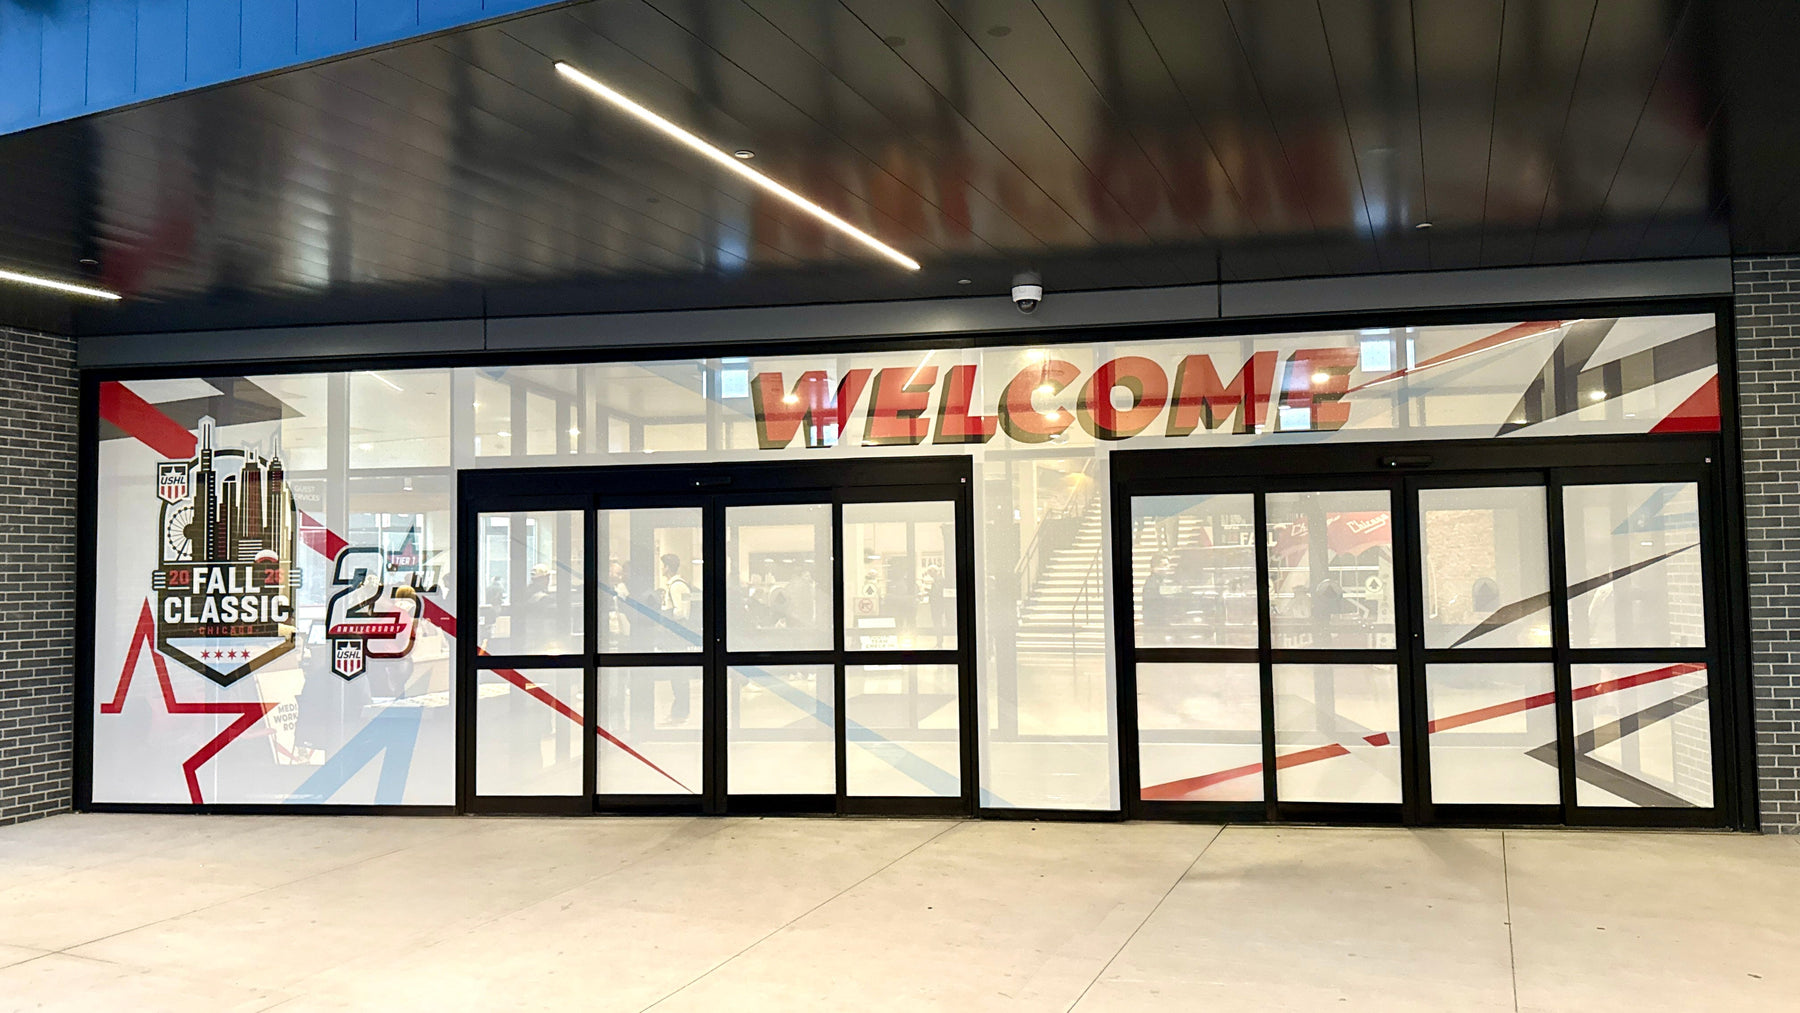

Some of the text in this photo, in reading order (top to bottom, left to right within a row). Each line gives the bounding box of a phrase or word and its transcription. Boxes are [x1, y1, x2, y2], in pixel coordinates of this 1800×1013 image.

[750, 348, 1361, 450] WELCOME
[160, 475, 186, 485] USHL
[293, 494, 320, 502] ERVICES
[1240, 532, 1278, 547] FAL
[395, 556, 411, 565] TIER
[921, 557, 945, 568] RAIS
[169, 566, 286, 595] 20 FALL 26
[164, 595, 290, 624] CLASSIC
[198, 625, 254, 635] CHICAGO
[336, 625, 401, 633] ANNIVERSARY
[336, 650, 361, 659] USHL
[278, 703, 298, 714] MEDI
